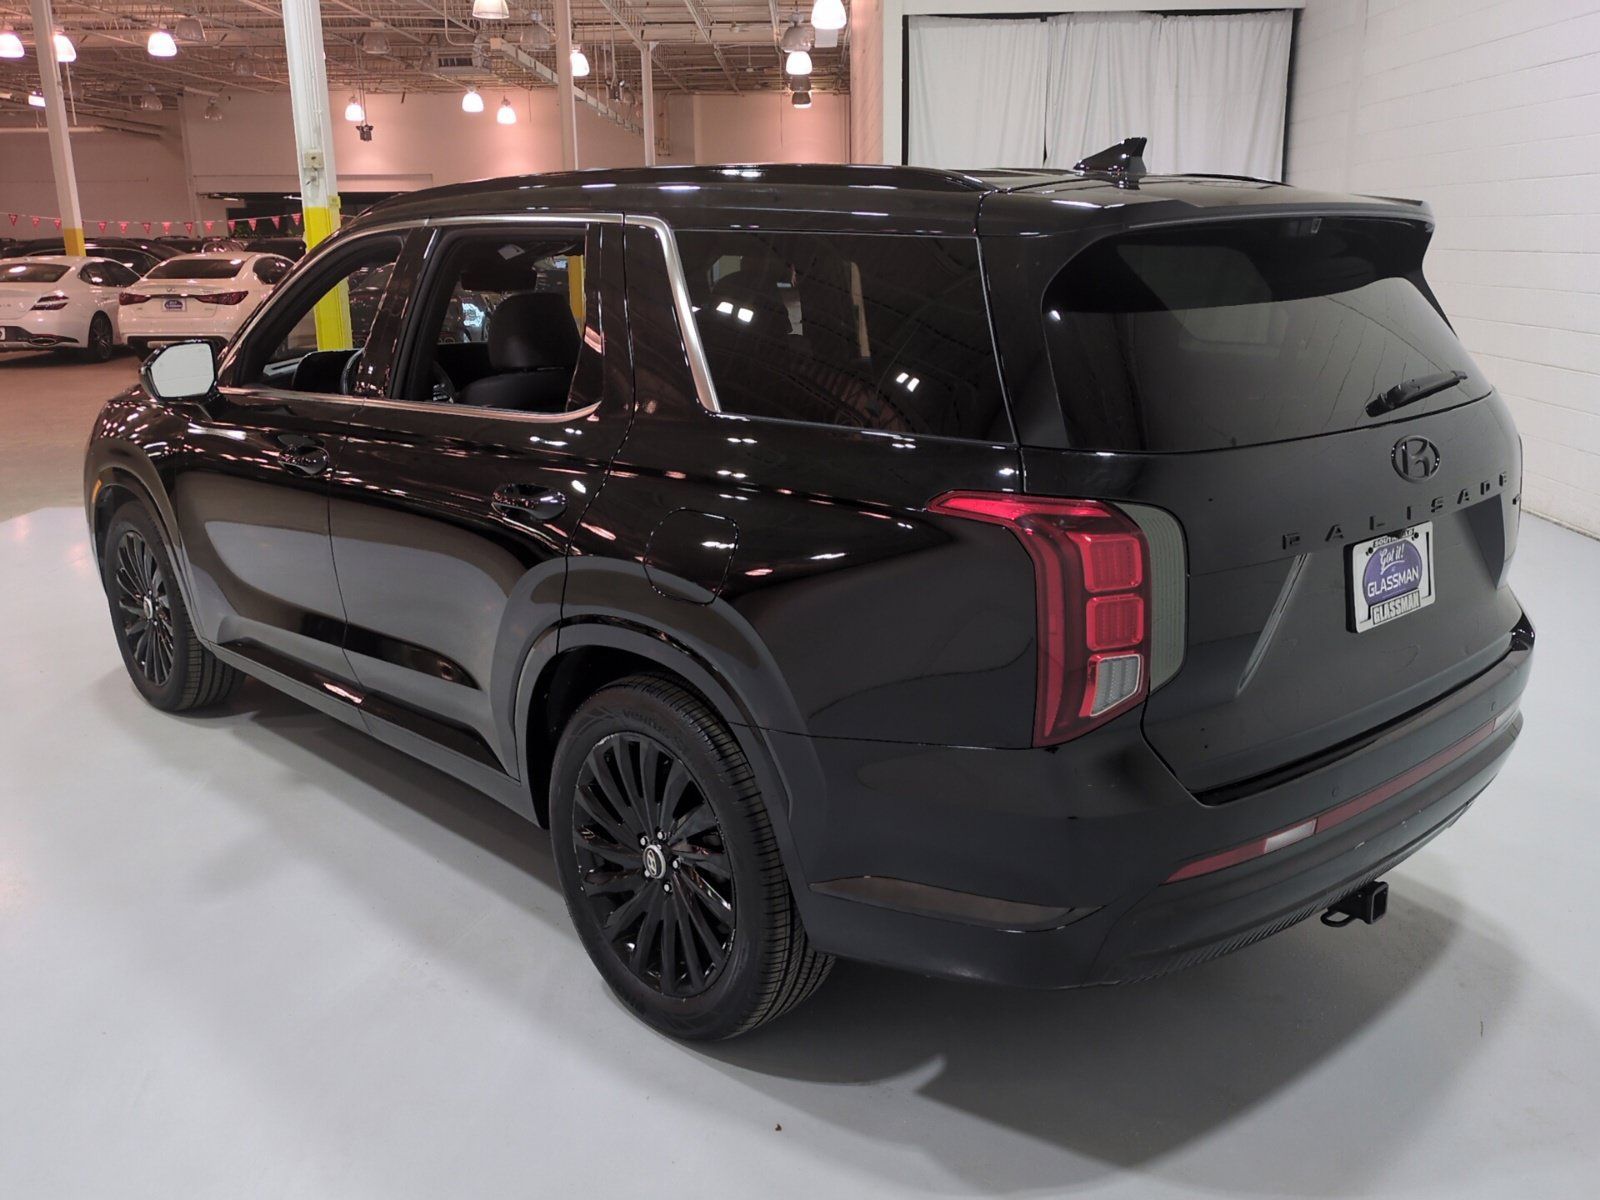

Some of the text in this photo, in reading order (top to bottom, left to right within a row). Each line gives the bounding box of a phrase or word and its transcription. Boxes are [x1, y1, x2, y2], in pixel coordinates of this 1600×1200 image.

[1282, 474, 1507, 550] PALISADE
[1367, 566, 1419, 598] GLASSMAN
[1373, 590, 1419, 623] GLASSMAN
